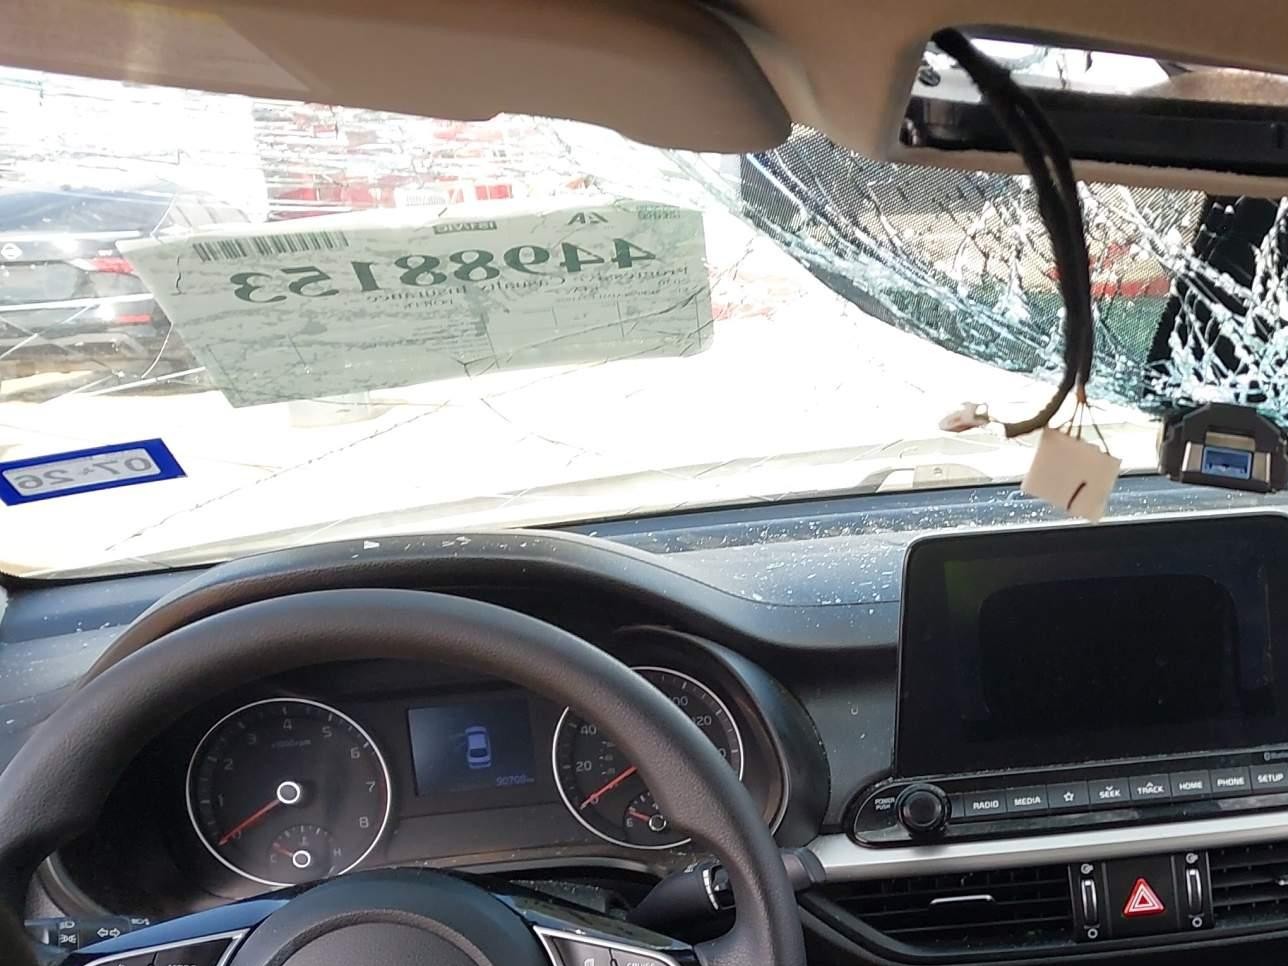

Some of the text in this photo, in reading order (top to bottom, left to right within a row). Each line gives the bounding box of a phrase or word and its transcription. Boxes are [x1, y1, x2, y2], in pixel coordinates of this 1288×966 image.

[283, 719, 292, 730] 4
[322, 726, 332, 738] 5
[580, 725, 597, 735] 40
[249, 735, 257, 744] 3
[351, 748, 360, 759] 6
[224, 759, 233, 770] 2
[576, 761, 592, 771] 20
[1217, 777, 1245, 787] PHONE
[1257, 773, 1284, 783] SETUP
[366, 781, 376, 792] 7
[1137, 785, 1165, 795] TRACK
[1179, 781, 1203, 790] HOME
[1099, 789, 1121, 799] SEEK
[973, 800, 999, 810] RADIO
[1014, 796, 1041, 806] MEDIA
[360, 816, 369, 828] 8
